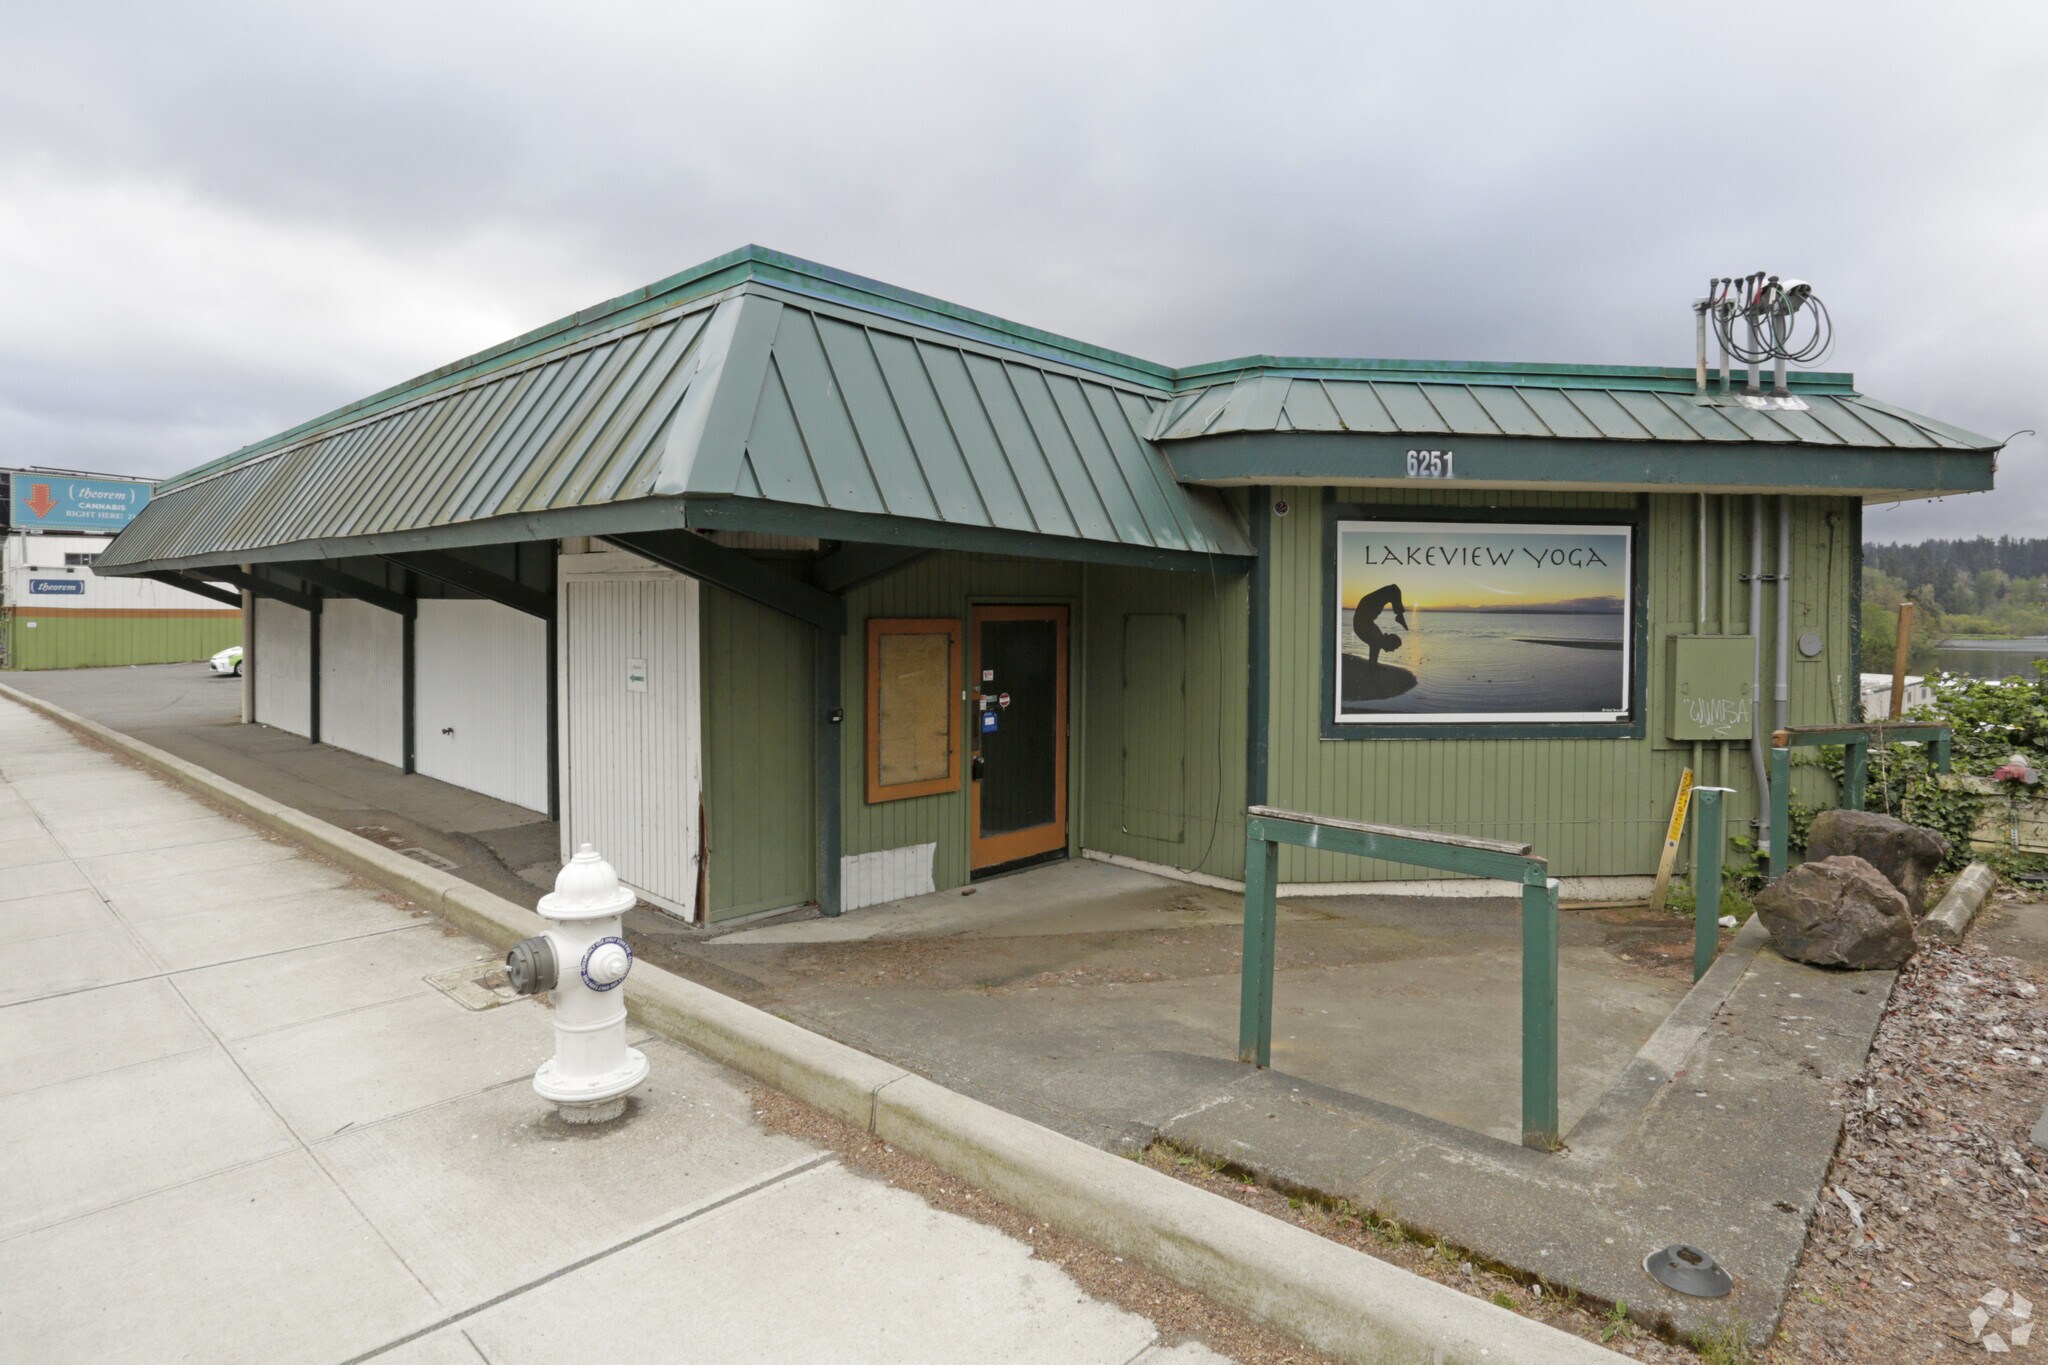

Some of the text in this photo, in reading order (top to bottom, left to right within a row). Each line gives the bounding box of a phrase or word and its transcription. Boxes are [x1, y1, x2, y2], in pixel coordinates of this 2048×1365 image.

[1407, 450, 1453, 477] 6251
[66, 510, 96, 518] RIGHT
[79, 502, 126, 511] CANNABIS
[1365, 545, 1607, 568] LAKEVIEW YOGA
